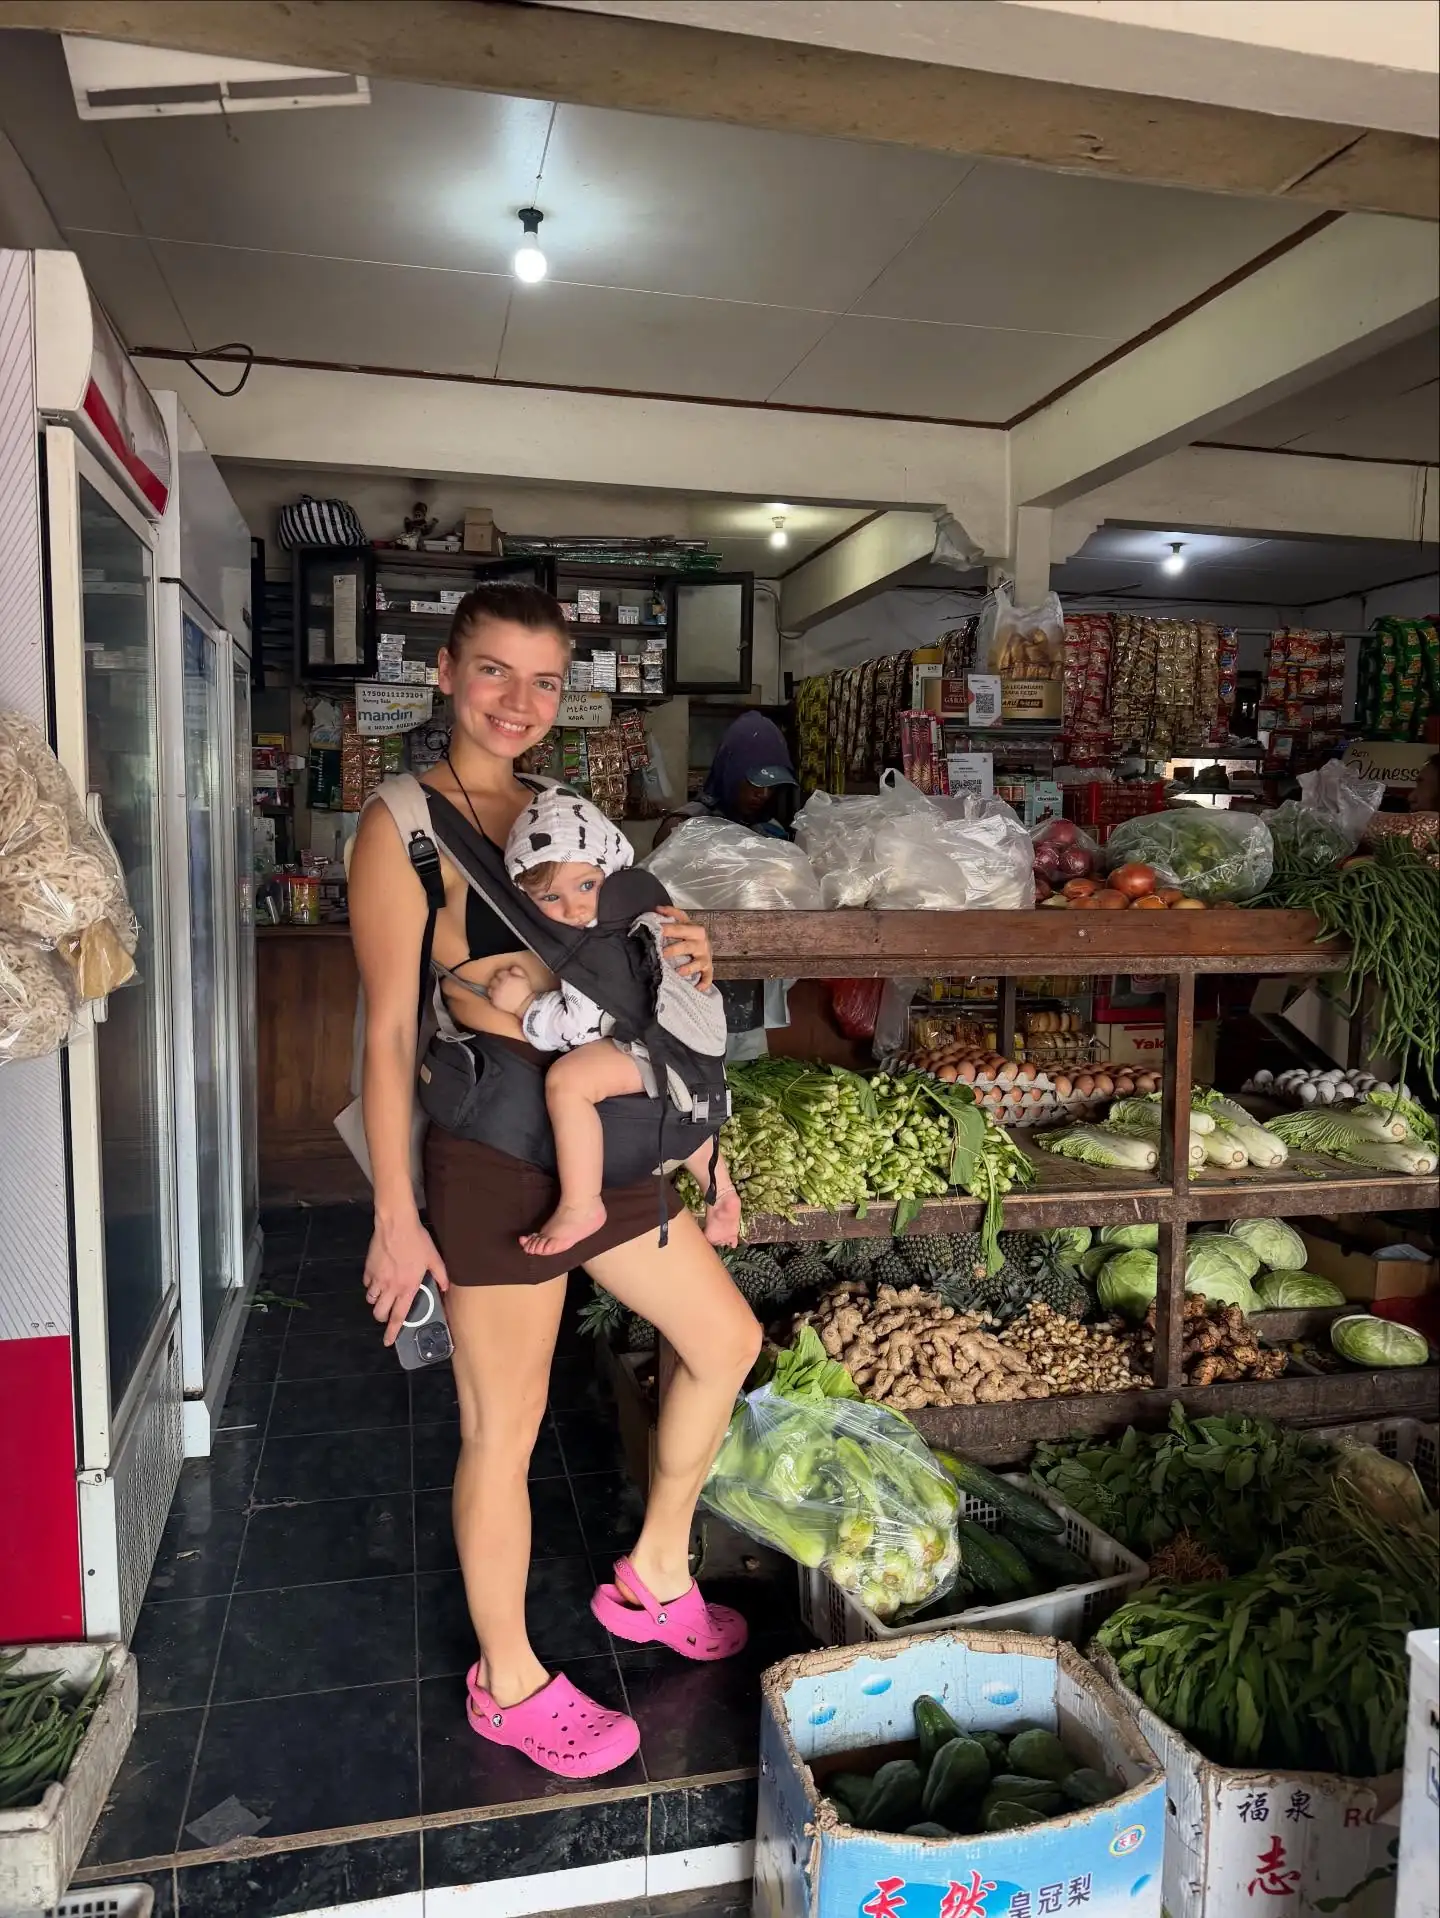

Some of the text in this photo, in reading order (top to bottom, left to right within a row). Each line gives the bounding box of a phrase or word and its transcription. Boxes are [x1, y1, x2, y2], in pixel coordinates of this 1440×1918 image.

[358, 709, 413, 721] mandiri
[1237, 1789, 1315, 1823] 福泉
[1247, 1835, 1301, 1897] 志
[1008, 1872, 1093, 1918] 皇冠梨
